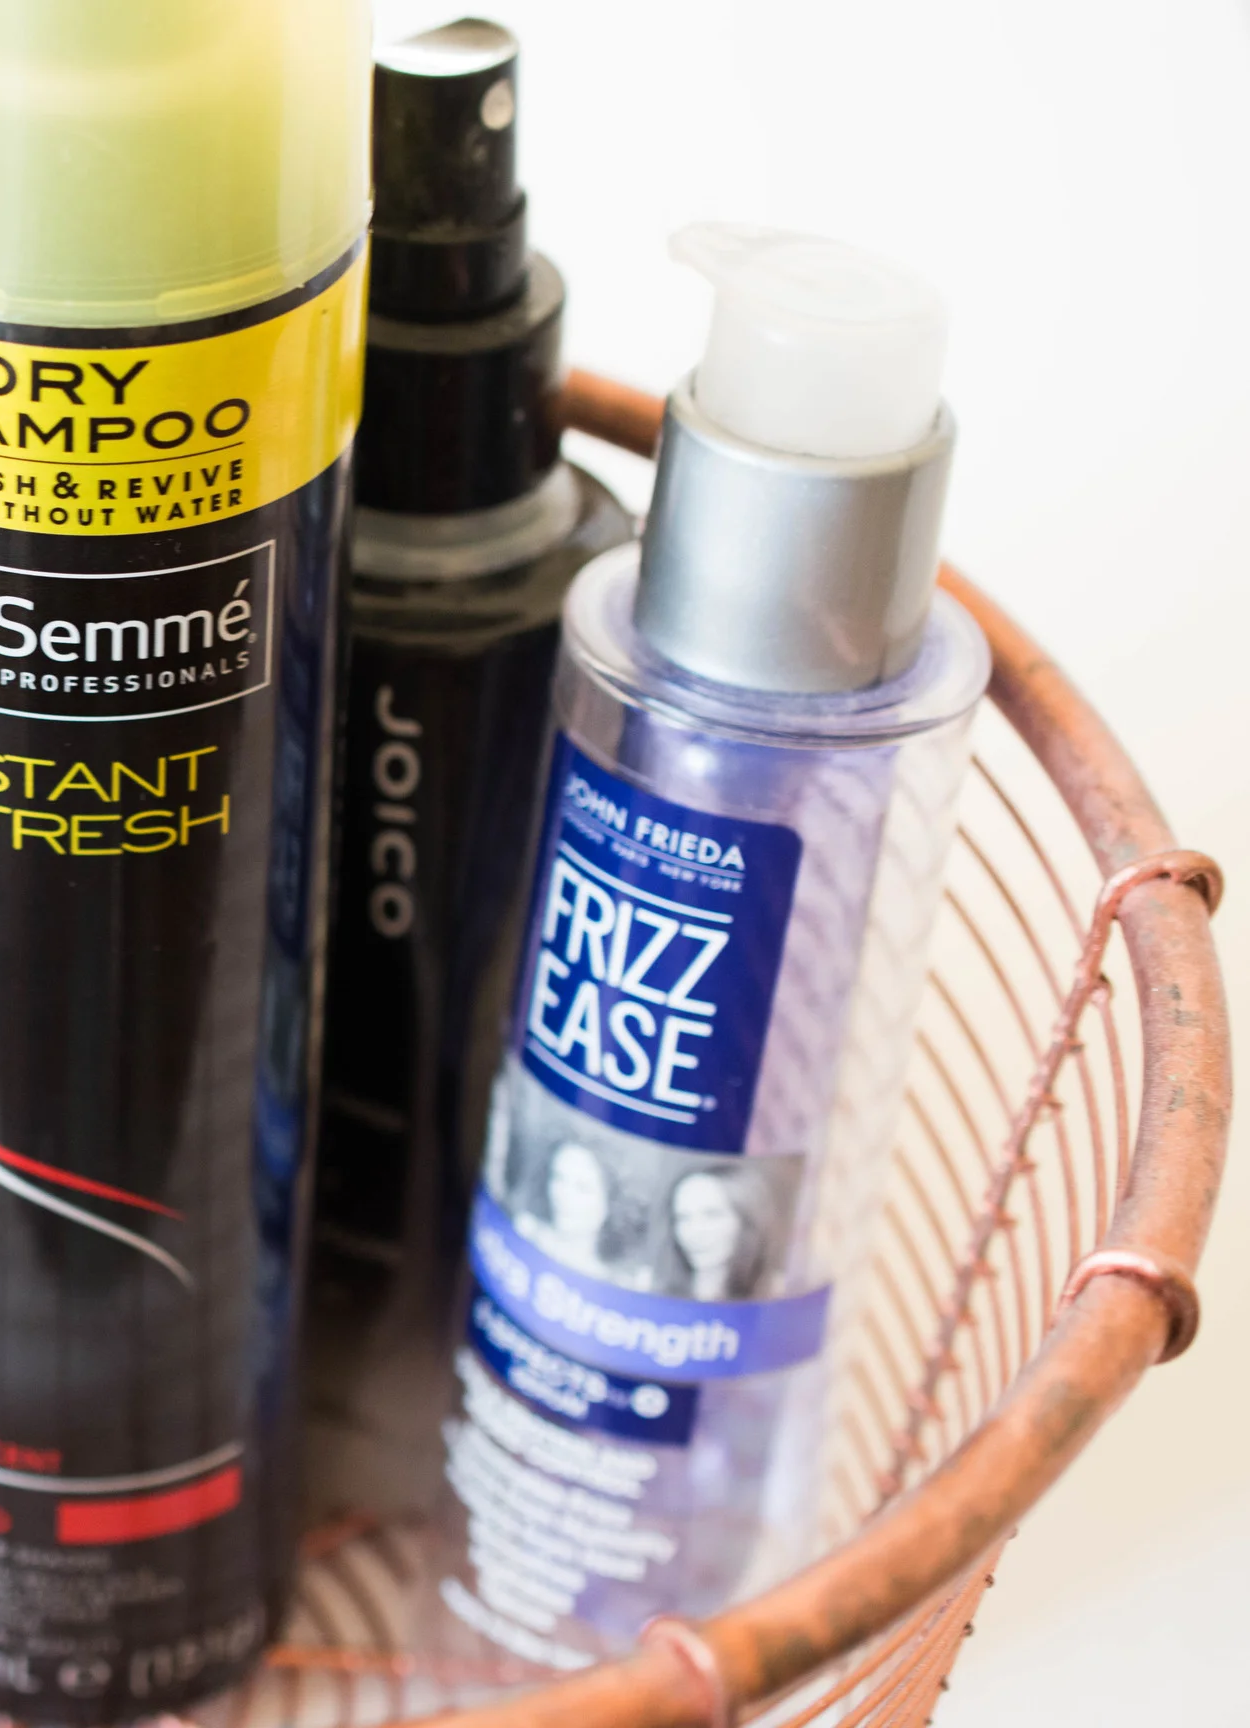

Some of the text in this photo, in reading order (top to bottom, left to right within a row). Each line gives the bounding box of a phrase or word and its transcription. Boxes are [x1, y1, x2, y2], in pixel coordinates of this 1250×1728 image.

[52, 471, 80, 499] &
[97, 459, 244, 500] REVIVE
[137, 488, 244, 525] WATER
[0, 651, 250, 694] PROFESSIONALS
[369, 684, 424, 938] JOICO
[565, 773, 746, 871] JOHN FRIEDA
[542, 856, 730, 1018] FRIZZ
[527, 948, 714, 1111] EASE
[532, 1272, 740, 1368] Strength
